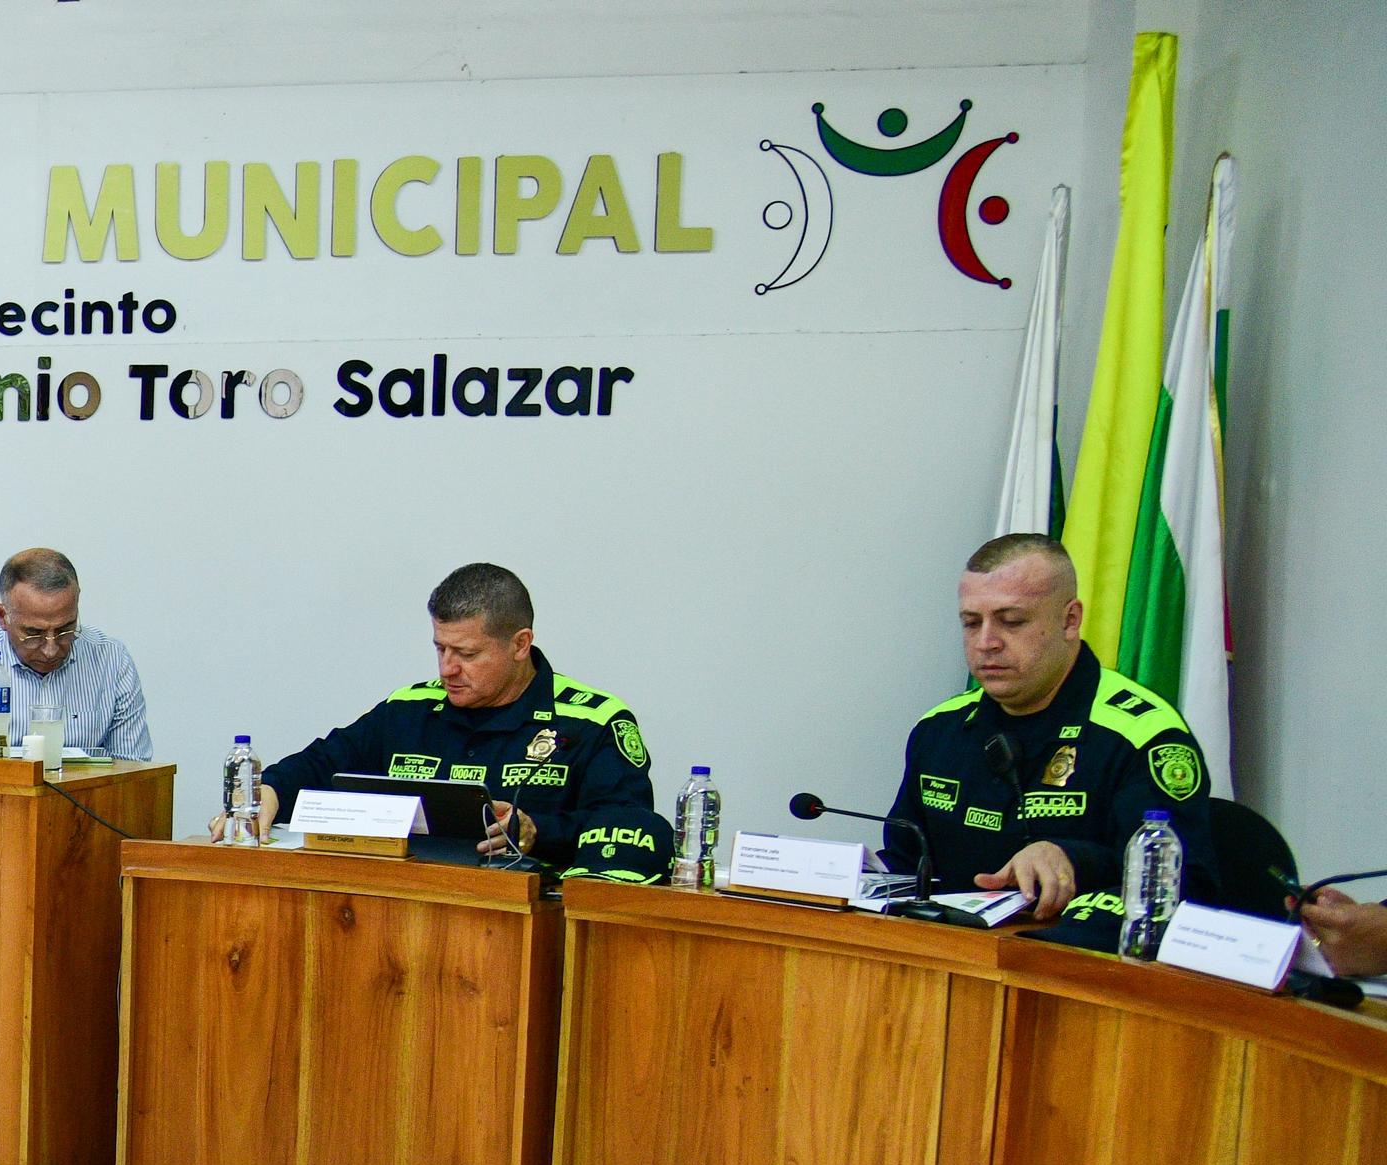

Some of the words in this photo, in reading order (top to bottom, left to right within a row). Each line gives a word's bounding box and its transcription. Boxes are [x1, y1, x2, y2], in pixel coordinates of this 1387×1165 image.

[42, 152, 713, 263] MUNICIPAL
[128, 364, 304, 420] Toro
[332, 354, 635, 418] Salazar
[452, 768, 483, 780] 000473
[1025, 796, 1077, 807] POLICÍA
[969, 811, 999, 827] 001421
[578, 827, 655, 852] POLICÍA
